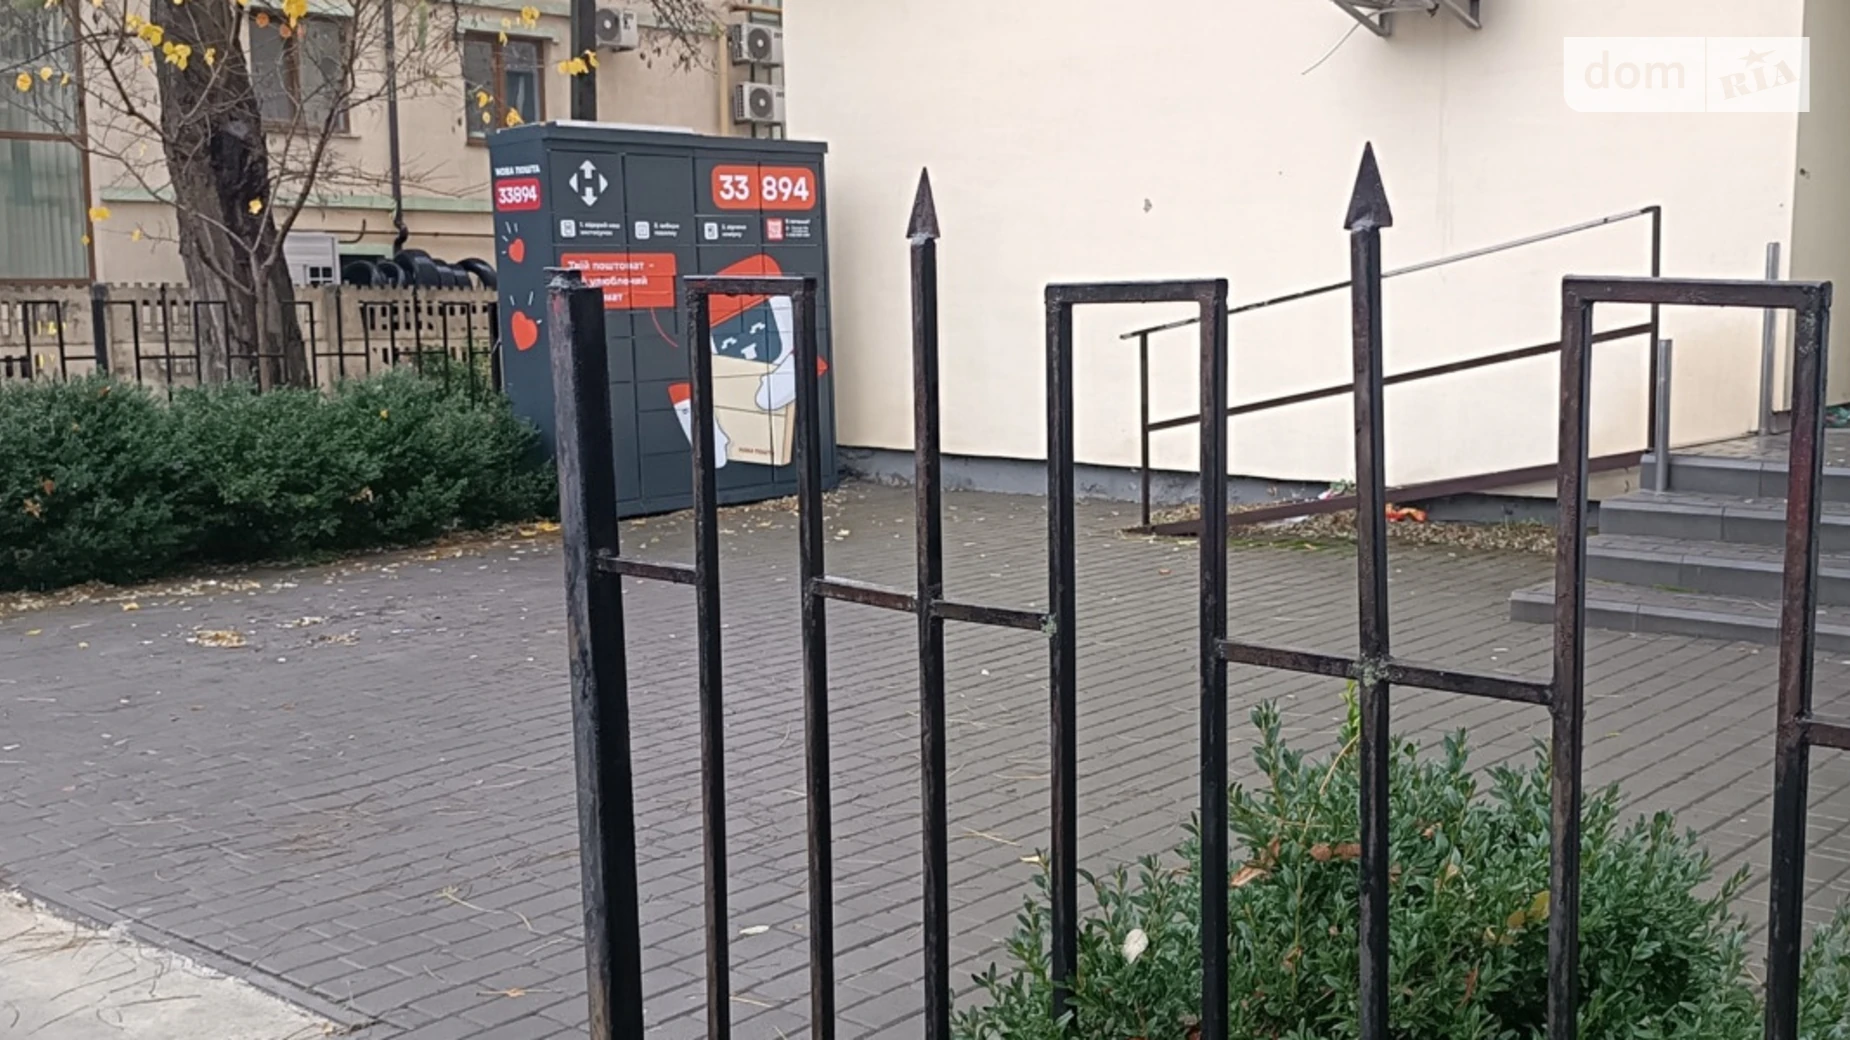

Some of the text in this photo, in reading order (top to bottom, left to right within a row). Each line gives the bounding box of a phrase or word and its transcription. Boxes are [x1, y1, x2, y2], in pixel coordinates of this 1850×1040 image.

[498, 185, 537, 204] 33894
[719, 174, 809, 201] 33 894
[592, 261, 645, 271] поштомат
